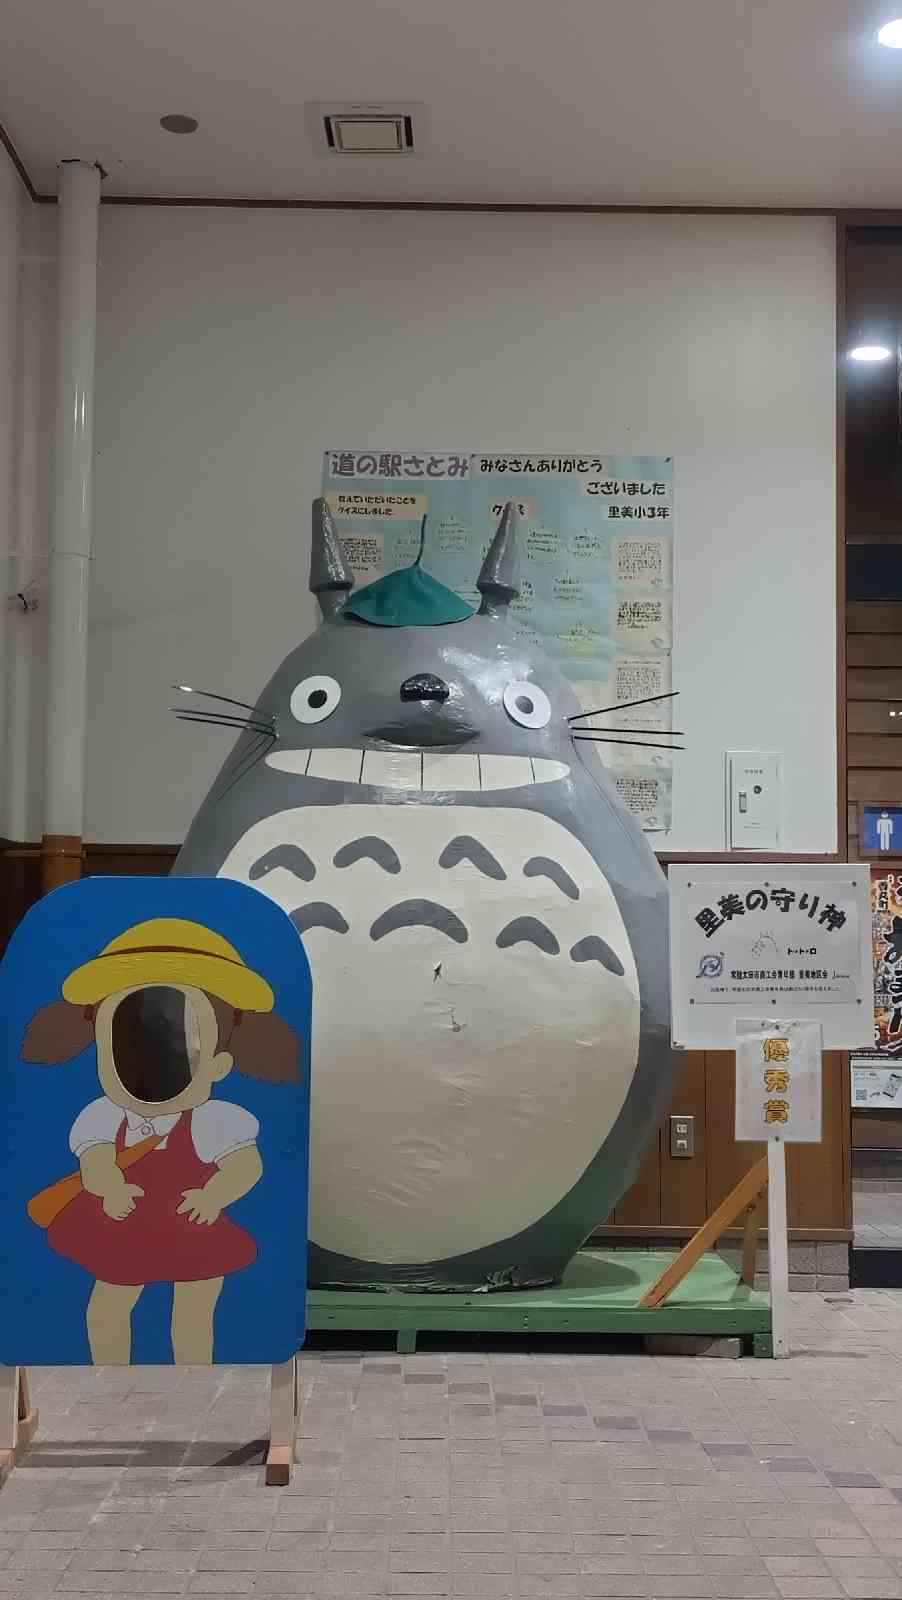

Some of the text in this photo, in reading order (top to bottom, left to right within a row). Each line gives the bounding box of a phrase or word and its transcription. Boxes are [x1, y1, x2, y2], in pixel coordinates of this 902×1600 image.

[332, 453, 468, 477] 道の駅さとみ
[480, 459, 602, 473] みなさんありがとう
[587, 481, 666, 496] ございました
[608, 506, 670, 519] 里美小3年
[695, 888, 847, 938] 里美の守り神
[763, 1038, 789, 1123] 優秀賞
